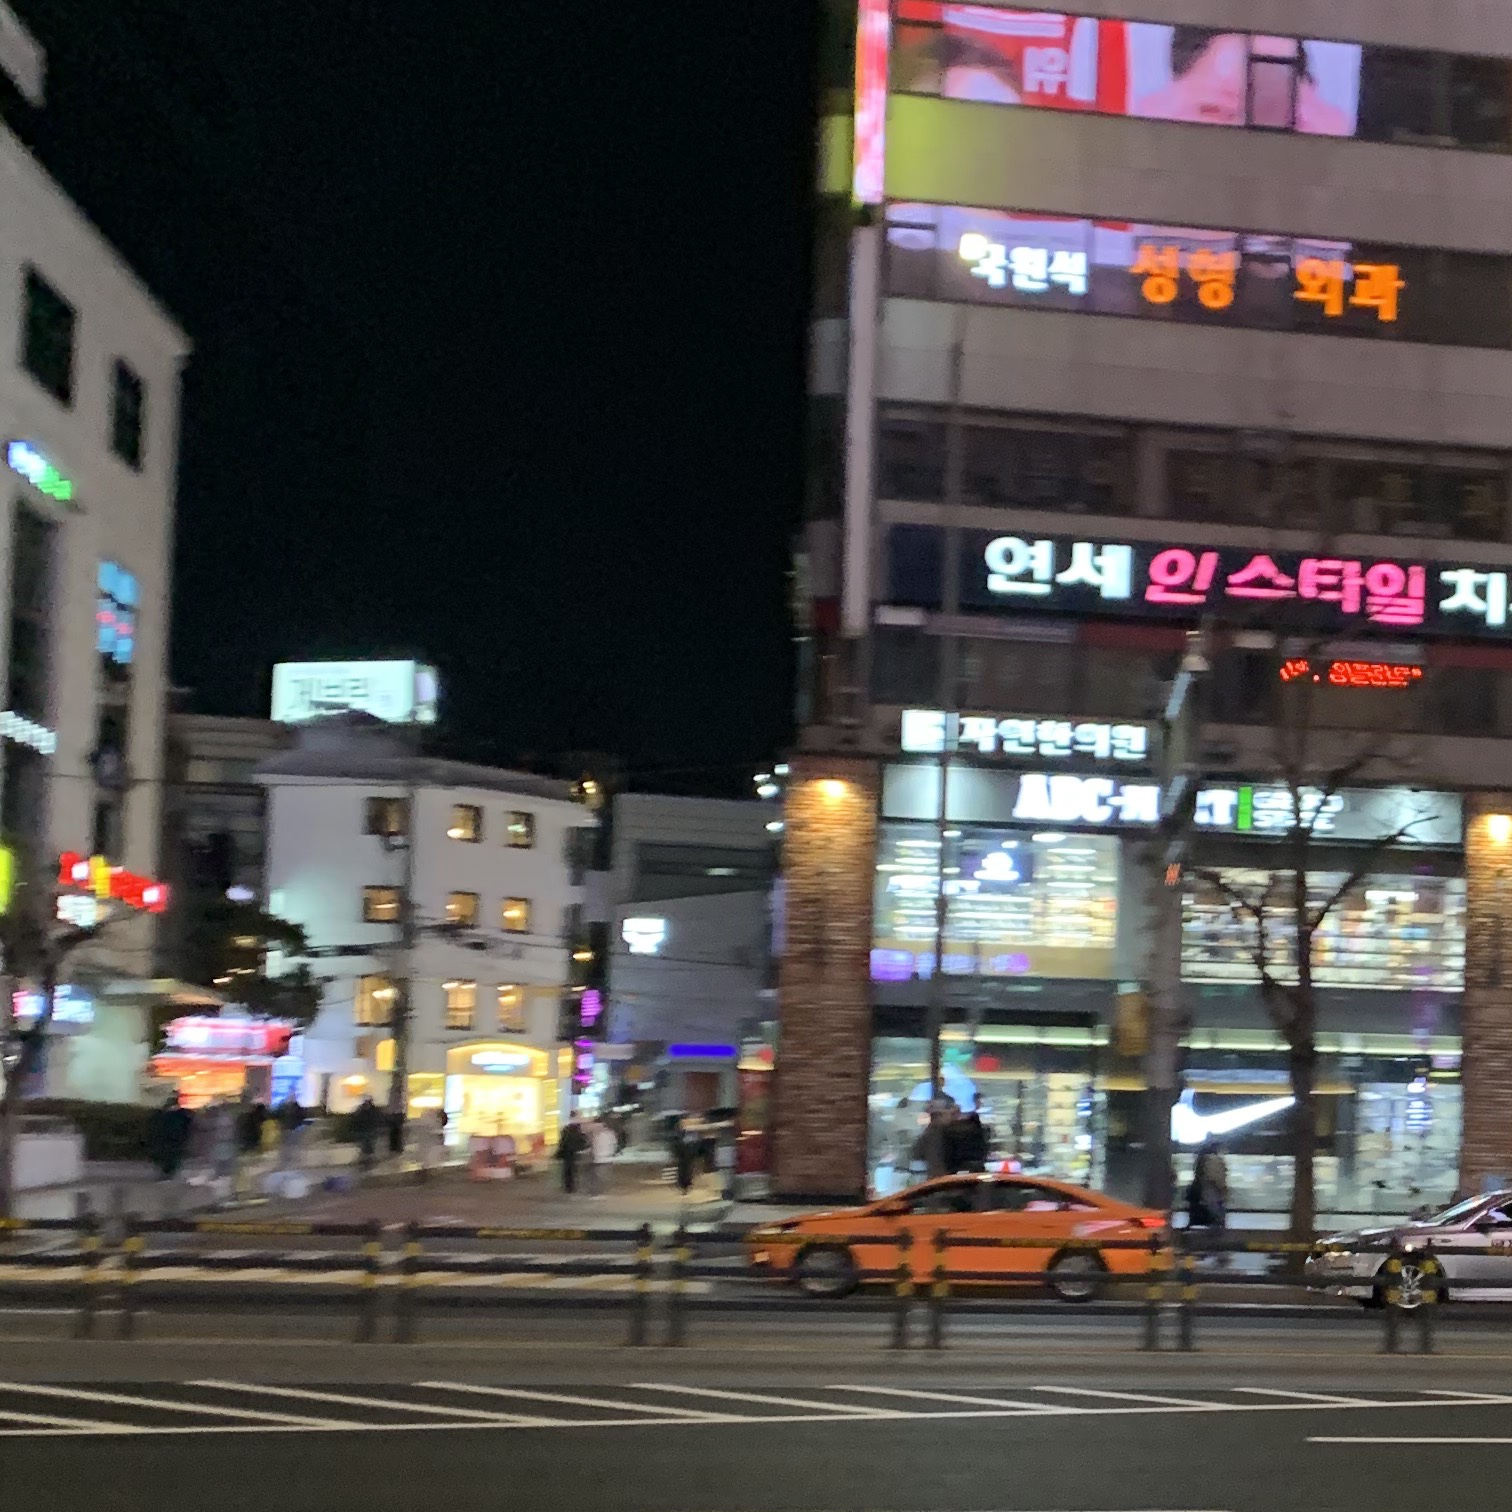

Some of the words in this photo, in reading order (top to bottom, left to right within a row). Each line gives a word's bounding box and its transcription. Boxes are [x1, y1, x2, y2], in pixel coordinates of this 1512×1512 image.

[1130, 245, 1235, 308] 성형
[1294, 258, 1405, 321] 외과
[984, 536, 1132, 598] 연세
[1145, 549, 1425, 625] 인스타일
